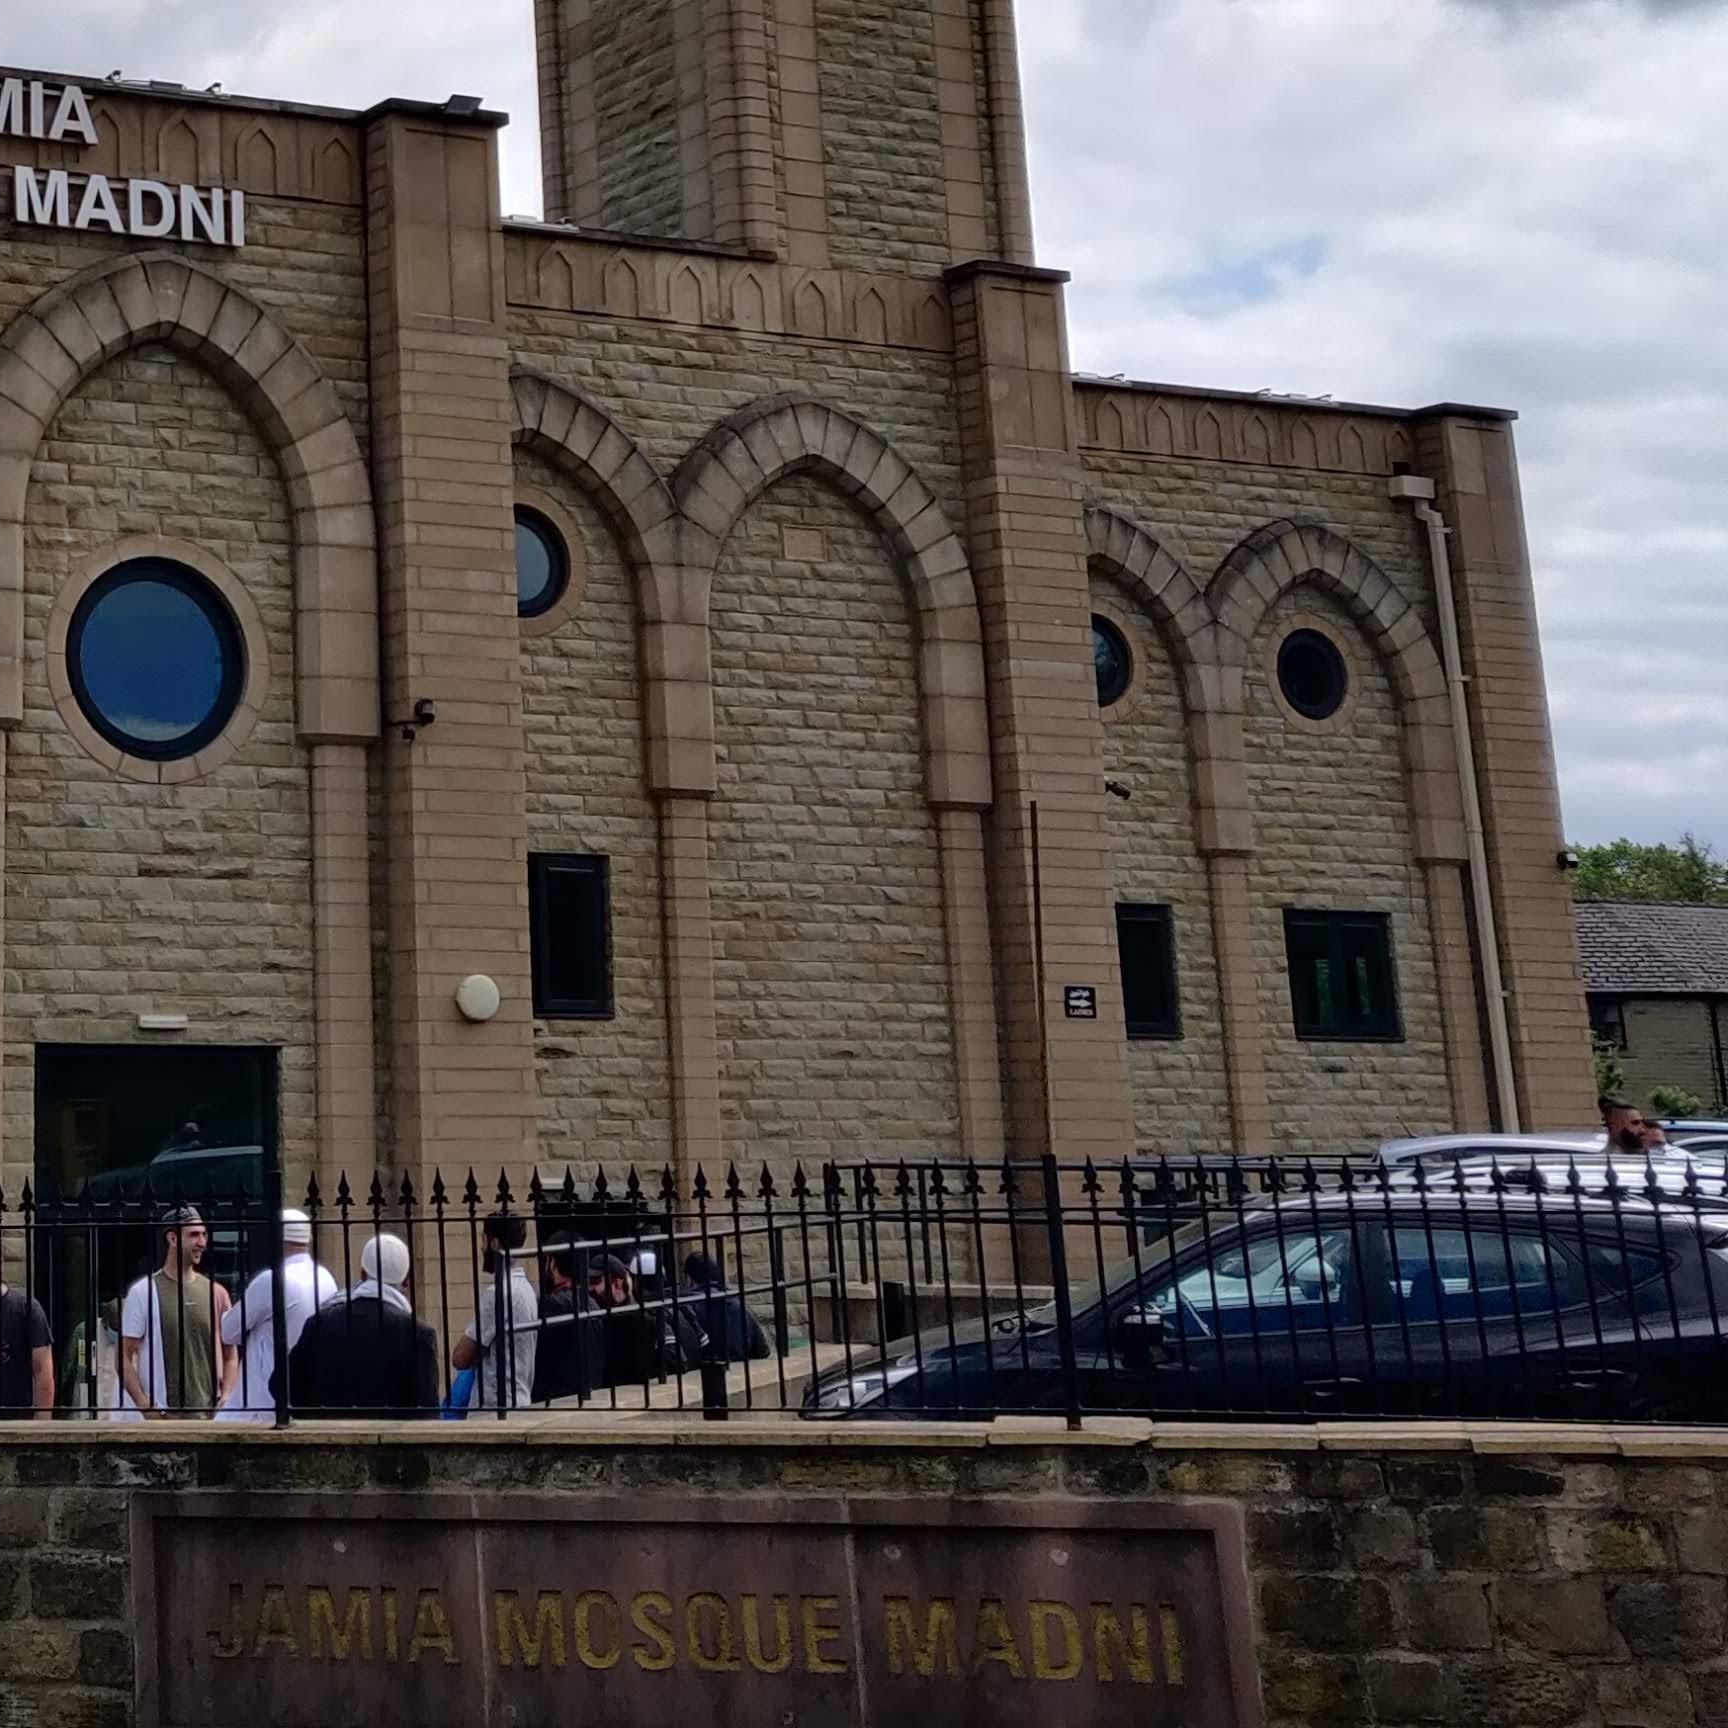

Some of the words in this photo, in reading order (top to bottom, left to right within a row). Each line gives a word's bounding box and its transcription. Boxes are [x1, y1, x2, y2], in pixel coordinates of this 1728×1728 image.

[14, 164, 245, 248] MADNI
[206, 1583, 462, 1667] JAMIA
[493, 1588, 848, 1672] MOSQUE
[882, 1594, 1184, 1685] MADNI
